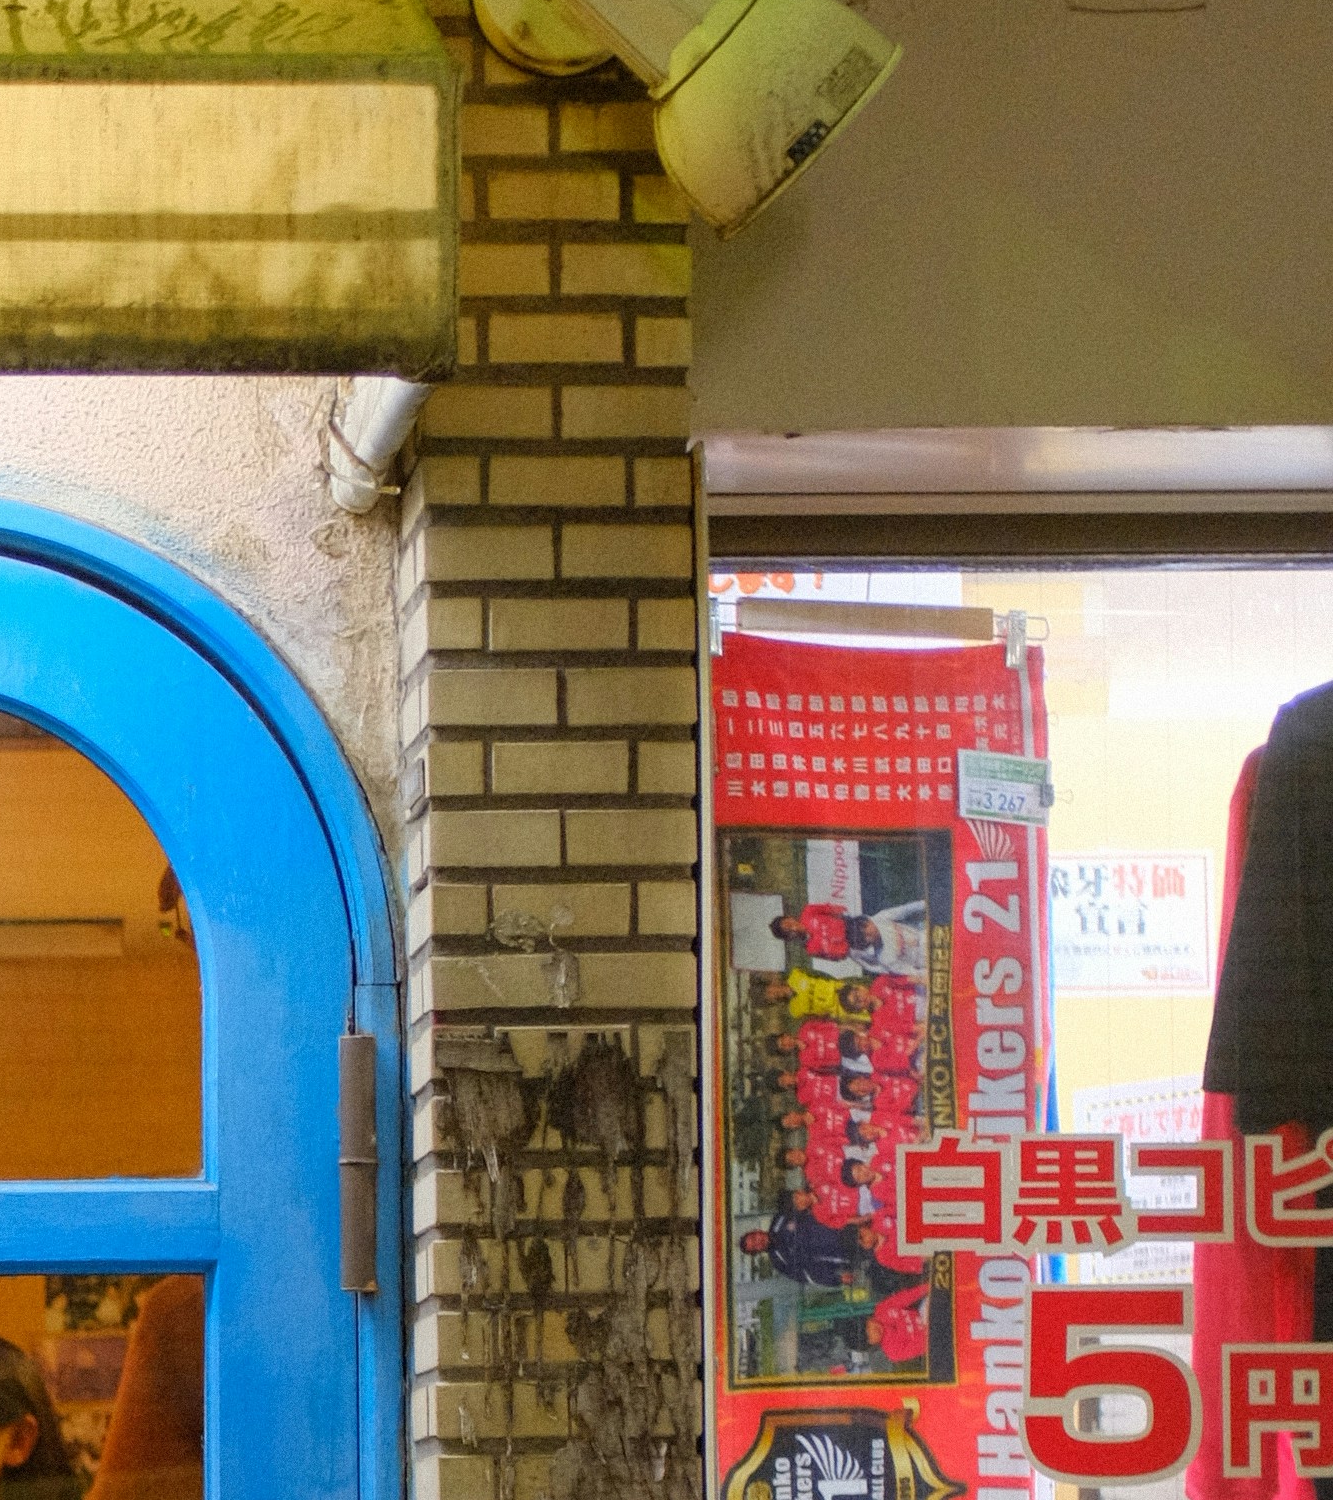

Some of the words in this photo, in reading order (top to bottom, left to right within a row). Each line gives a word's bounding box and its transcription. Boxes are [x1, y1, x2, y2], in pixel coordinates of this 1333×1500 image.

[963, 861, 1020, 933] 21
[967, 956, 1026, 1136] ikers
[970, 1257, 1031, 1477] Hanko
